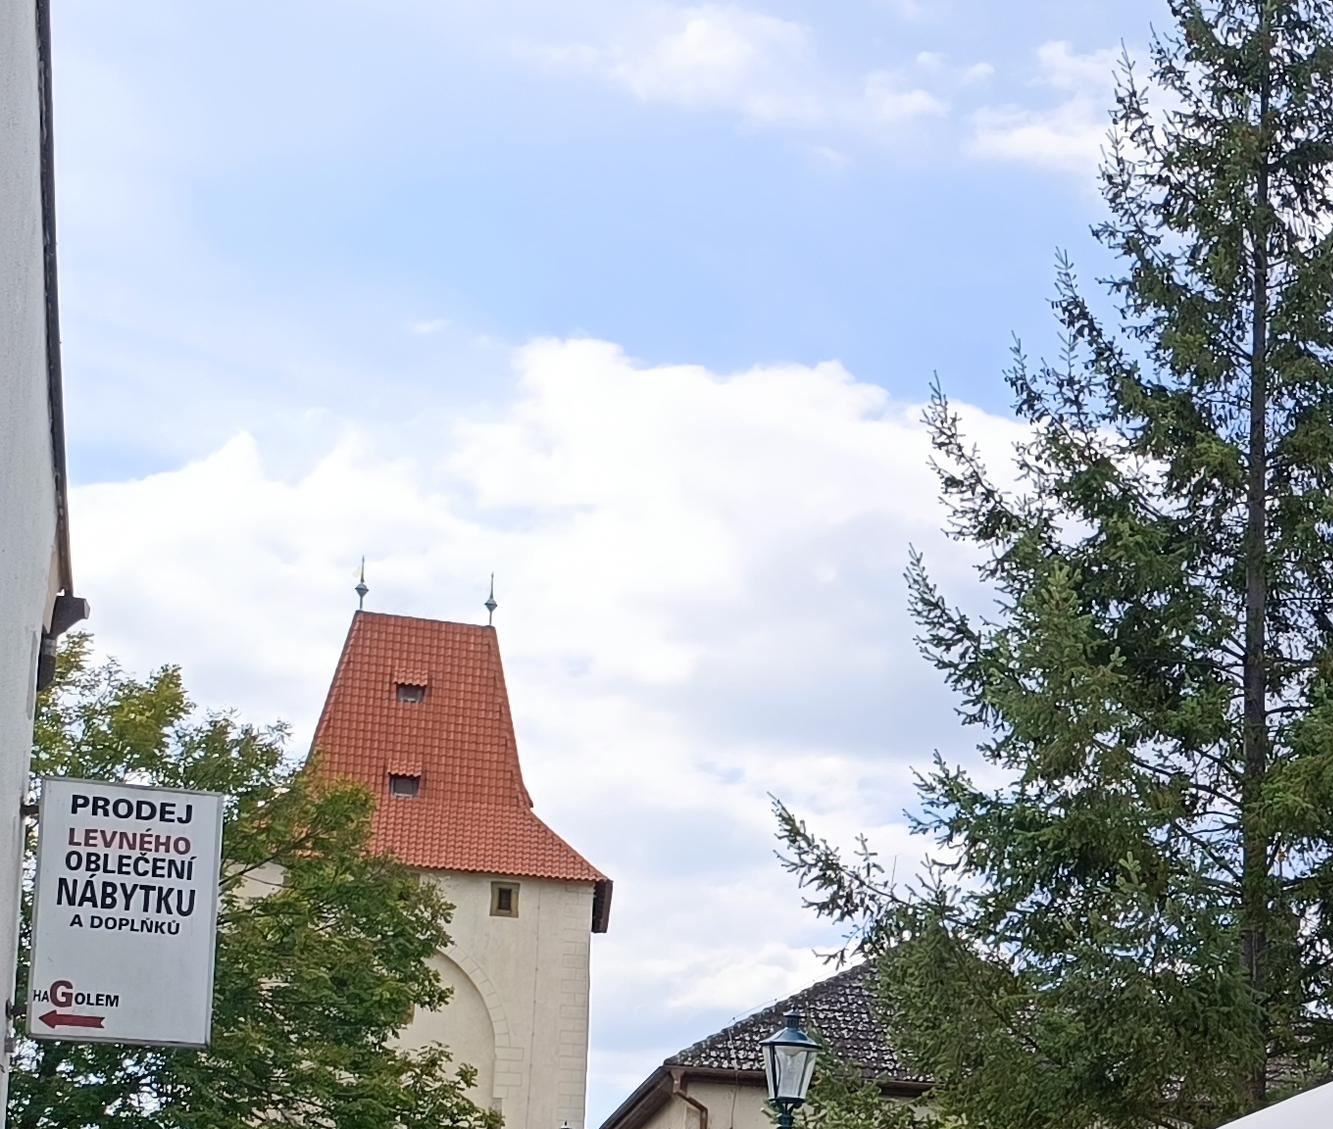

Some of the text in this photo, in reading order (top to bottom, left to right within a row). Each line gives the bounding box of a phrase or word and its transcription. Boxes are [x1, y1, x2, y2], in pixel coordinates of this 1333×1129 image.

[71, 794, 193, 824] PRODEJ
[68, 827, 191, 855] LEVNÉHO
[65, 851, 198, 880] OBLEČENÍ
[56, 873, 196, 917] NÁBYTKU
[69, 914, 181, 935] A DOPLŇKŮ
